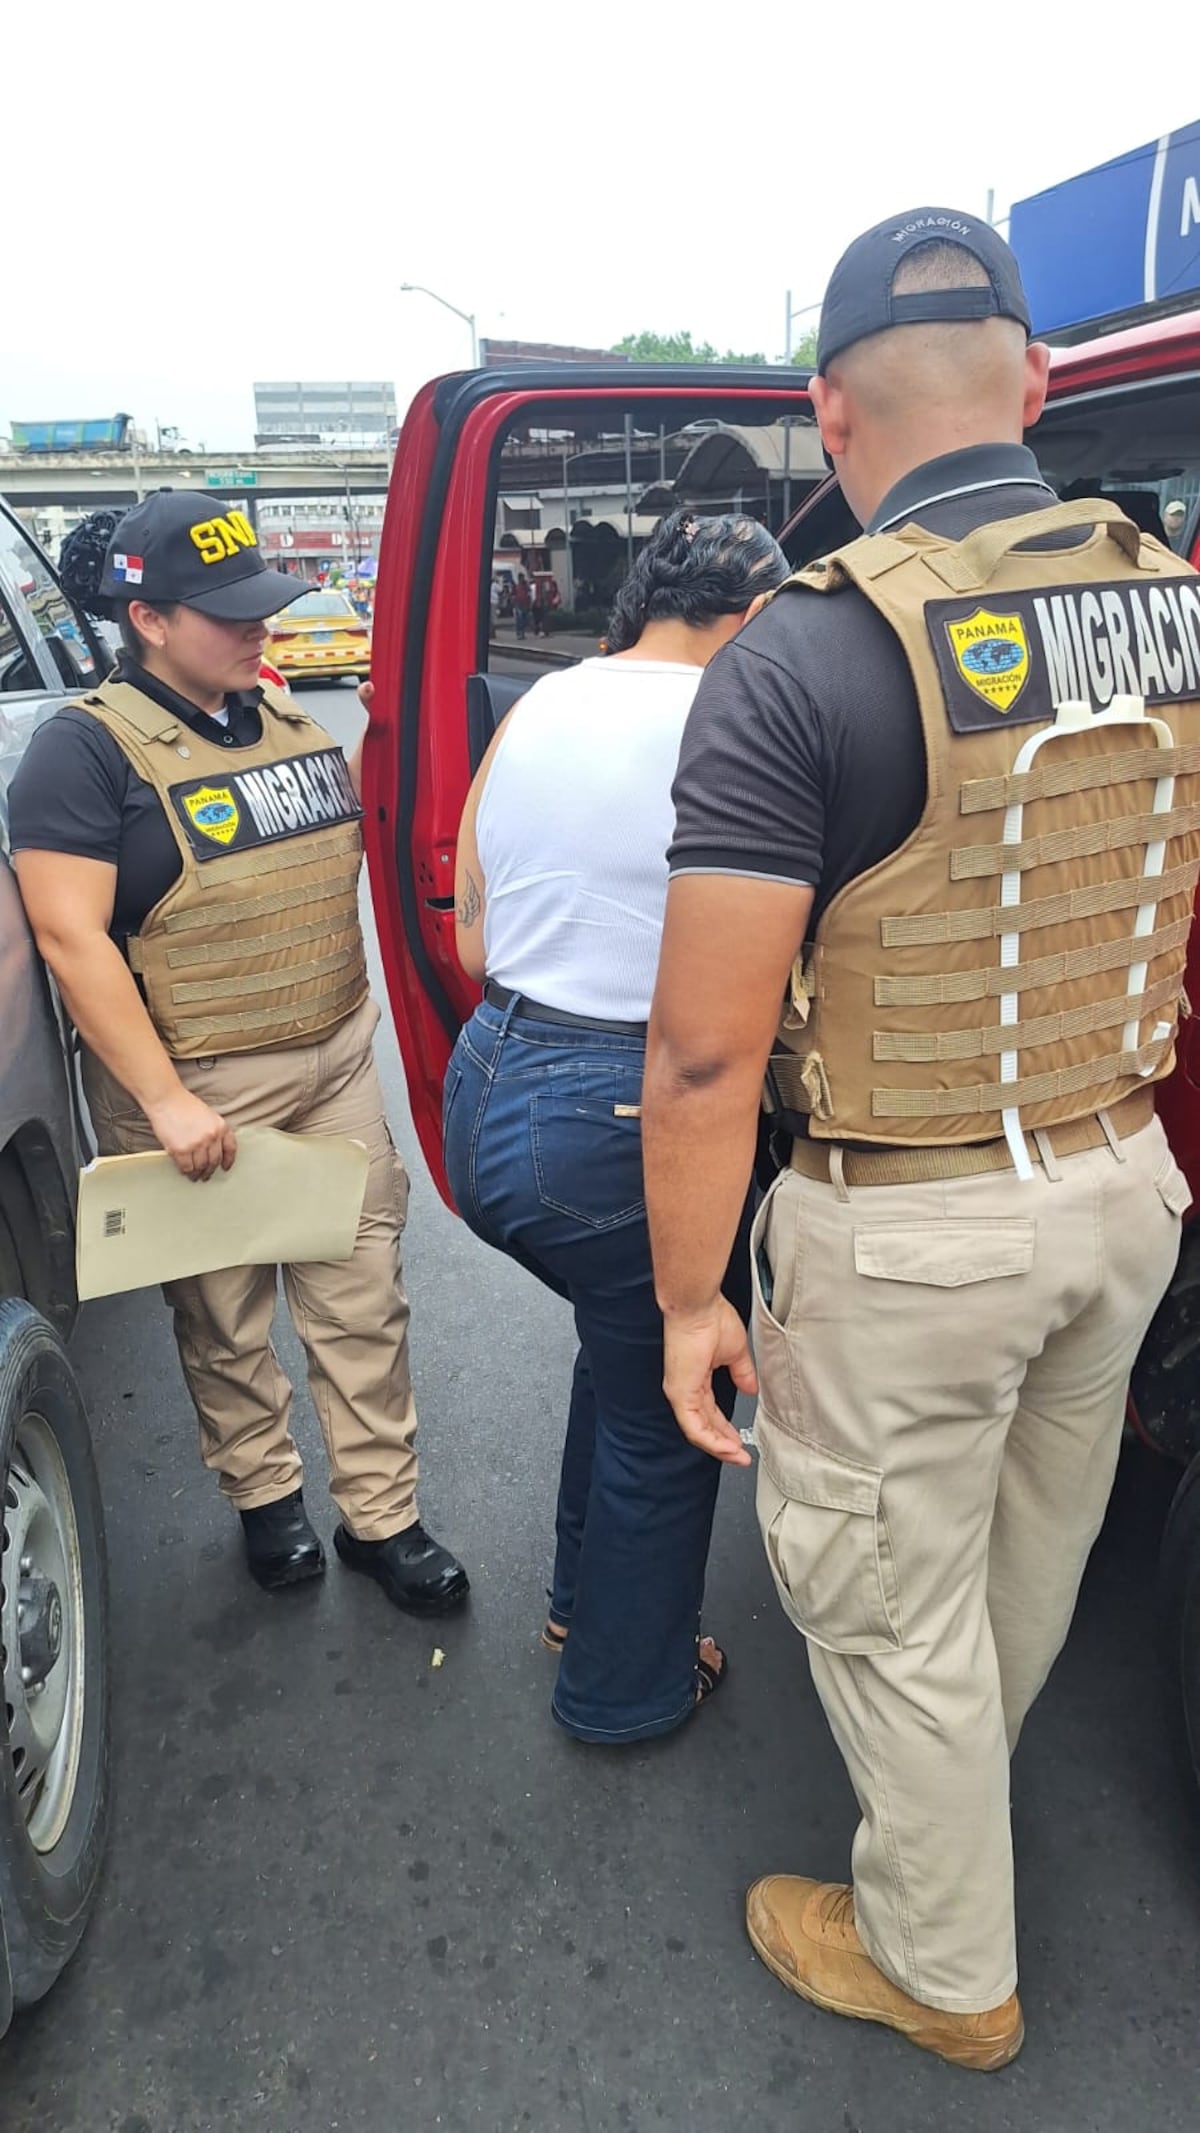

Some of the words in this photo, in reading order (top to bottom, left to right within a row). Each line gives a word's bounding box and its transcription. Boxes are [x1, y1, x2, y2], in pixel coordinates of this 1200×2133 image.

[956, 620, 1018, 640] PANAMÁ
[1033, 584, 1200, 709] MIGRACIO
[976, 673, 1022, 687] MIGRACIÓN
